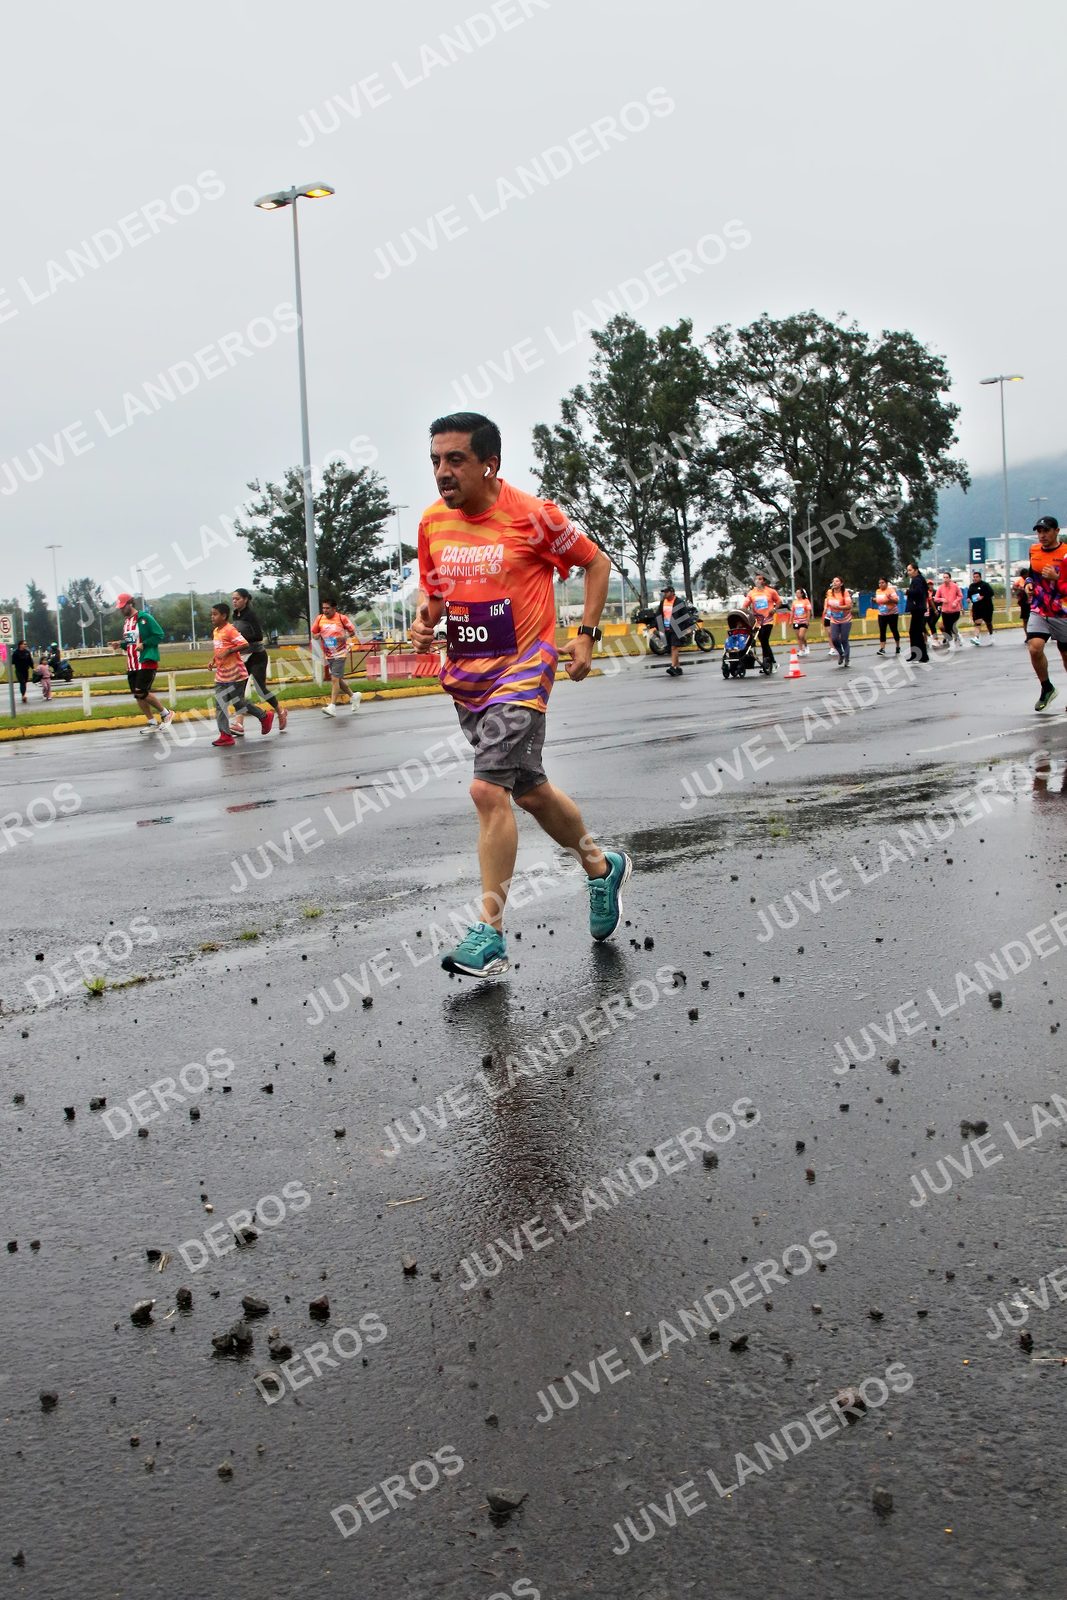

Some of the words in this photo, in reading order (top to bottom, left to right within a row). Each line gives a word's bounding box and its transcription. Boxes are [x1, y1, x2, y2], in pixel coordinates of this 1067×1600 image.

[441, 544, 504, 563] CARRERA
[972, 548, 982, 560] E
[440, 564, 486, 576] OMNILIFE
[457, 626, 489, 642] 390
